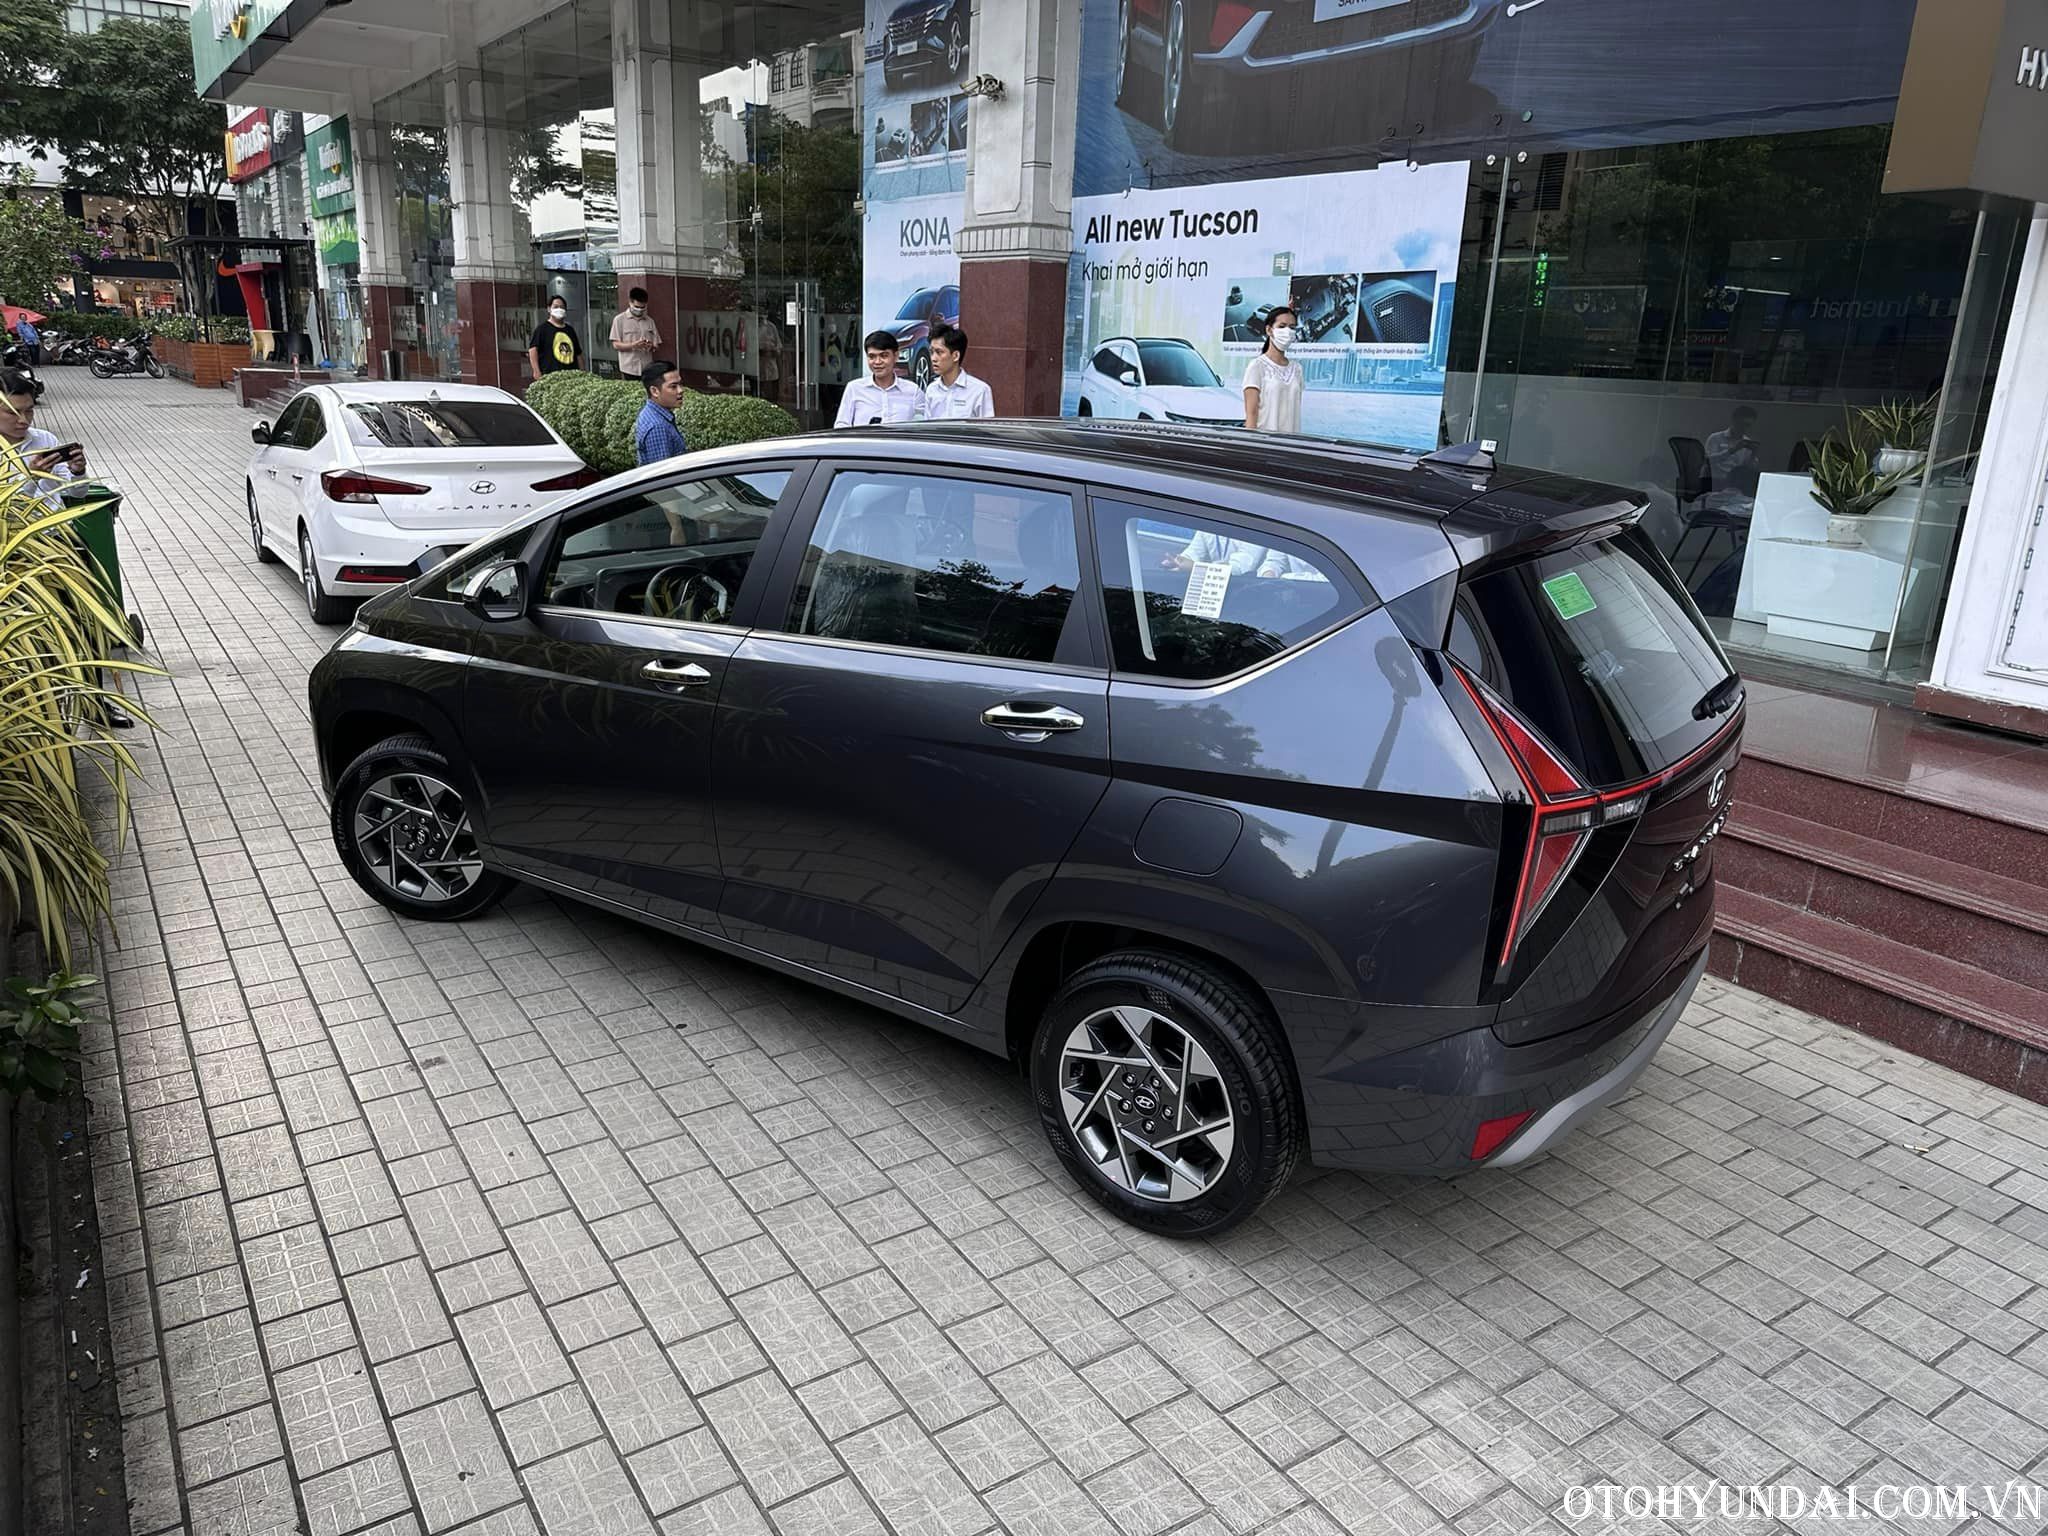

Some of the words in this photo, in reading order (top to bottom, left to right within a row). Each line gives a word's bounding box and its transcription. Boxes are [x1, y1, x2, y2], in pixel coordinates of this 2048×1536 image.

[900, 216, 951, 248] KONA
[1084, 214, 1112, 245] All
[1116, 217, 1165, 243] new
[1169, 208, 1259, 240] Tucson
[1082, 259, 1113, 281] Khai
[1116, 257, 1142, 281] mở
[1145, 256, 1174, 284] giới
[1177, 256, 1209, 283] hạn
